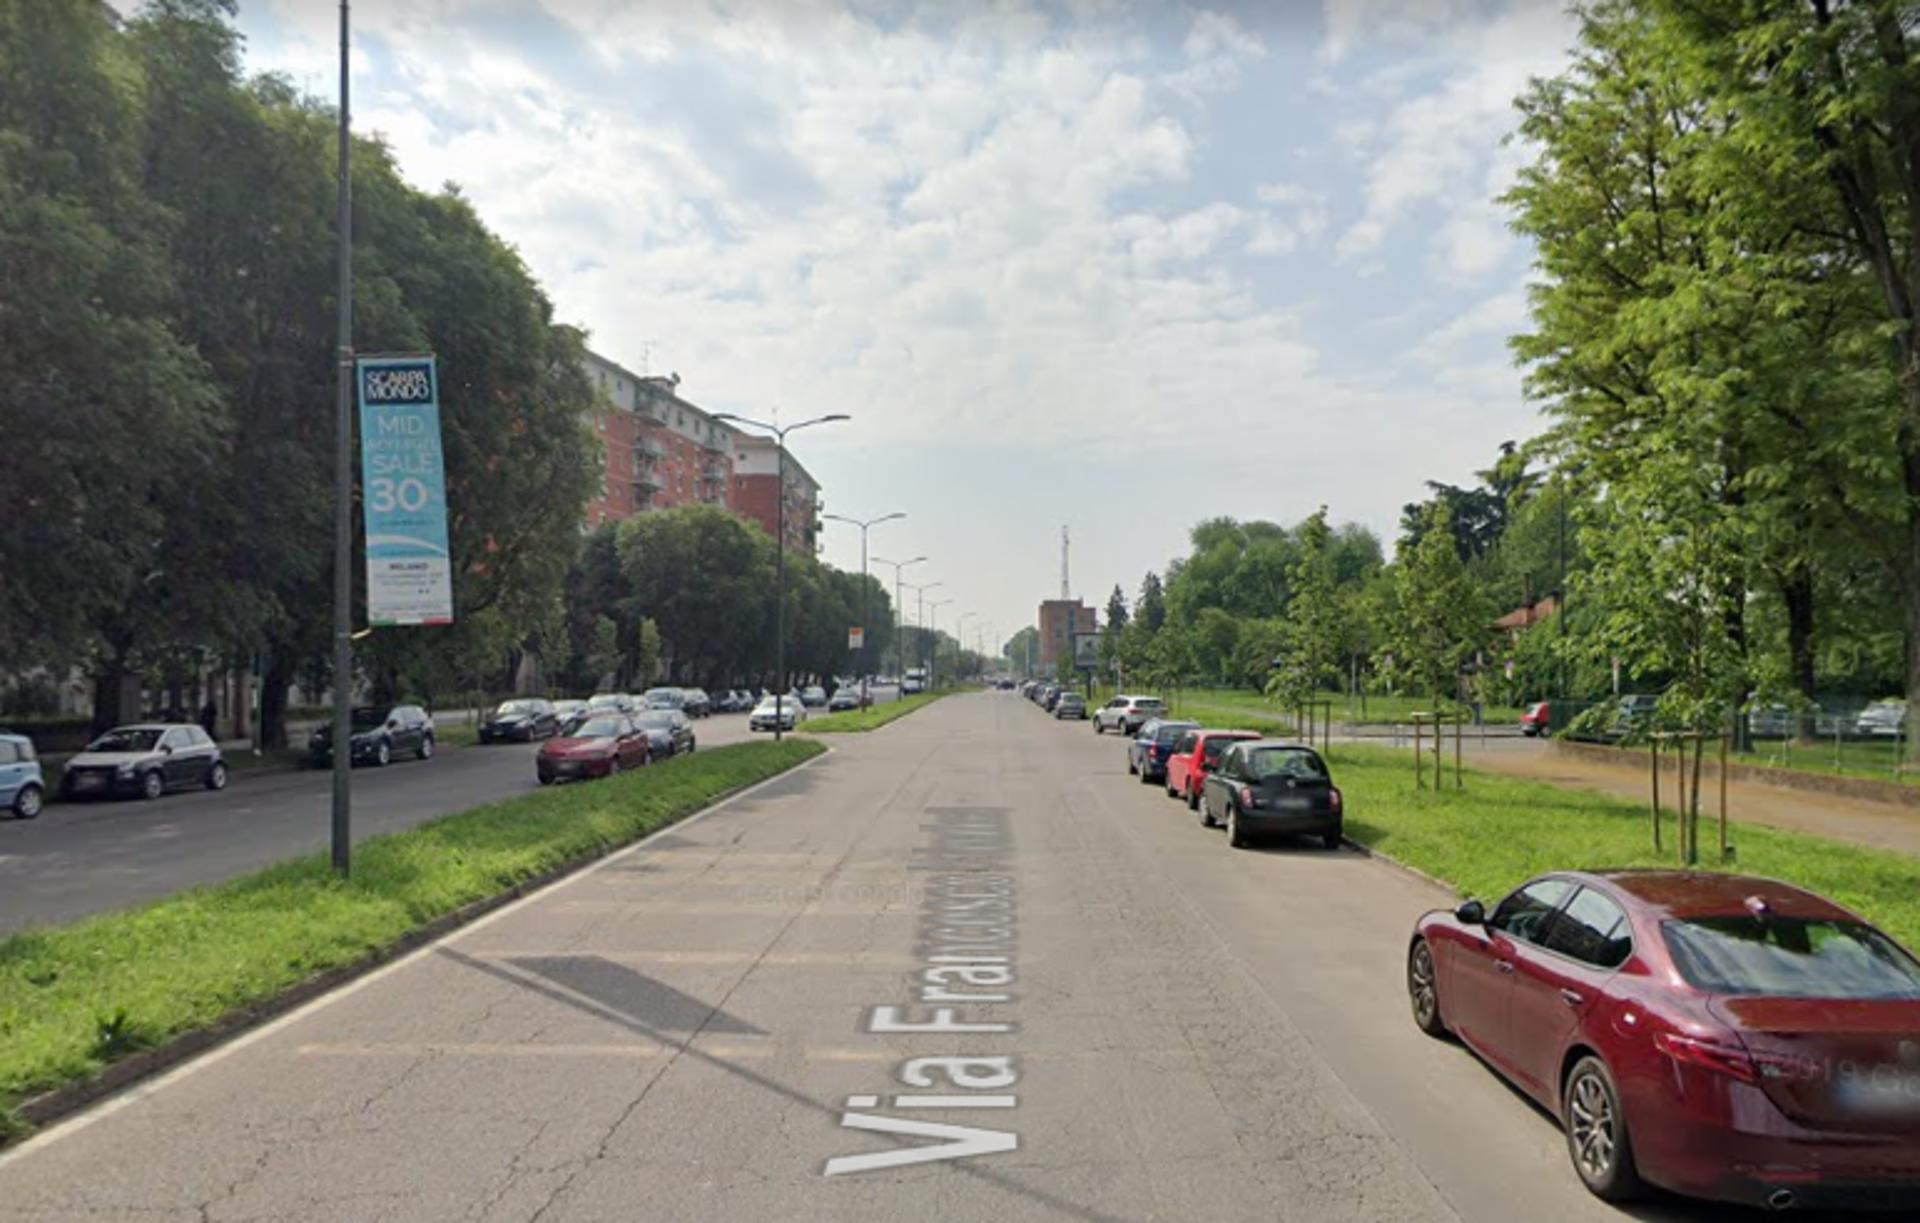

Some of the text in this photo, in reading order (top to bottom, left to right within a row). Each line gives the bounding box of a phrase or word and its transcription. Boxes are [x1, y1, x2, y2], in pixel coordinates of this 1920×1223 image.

[366, 382, 430, 399] MONDO
[377, 415, 425, 435] MID
[370, 452, 434, 473] SALE
[369, 477, 428, 512] 30
